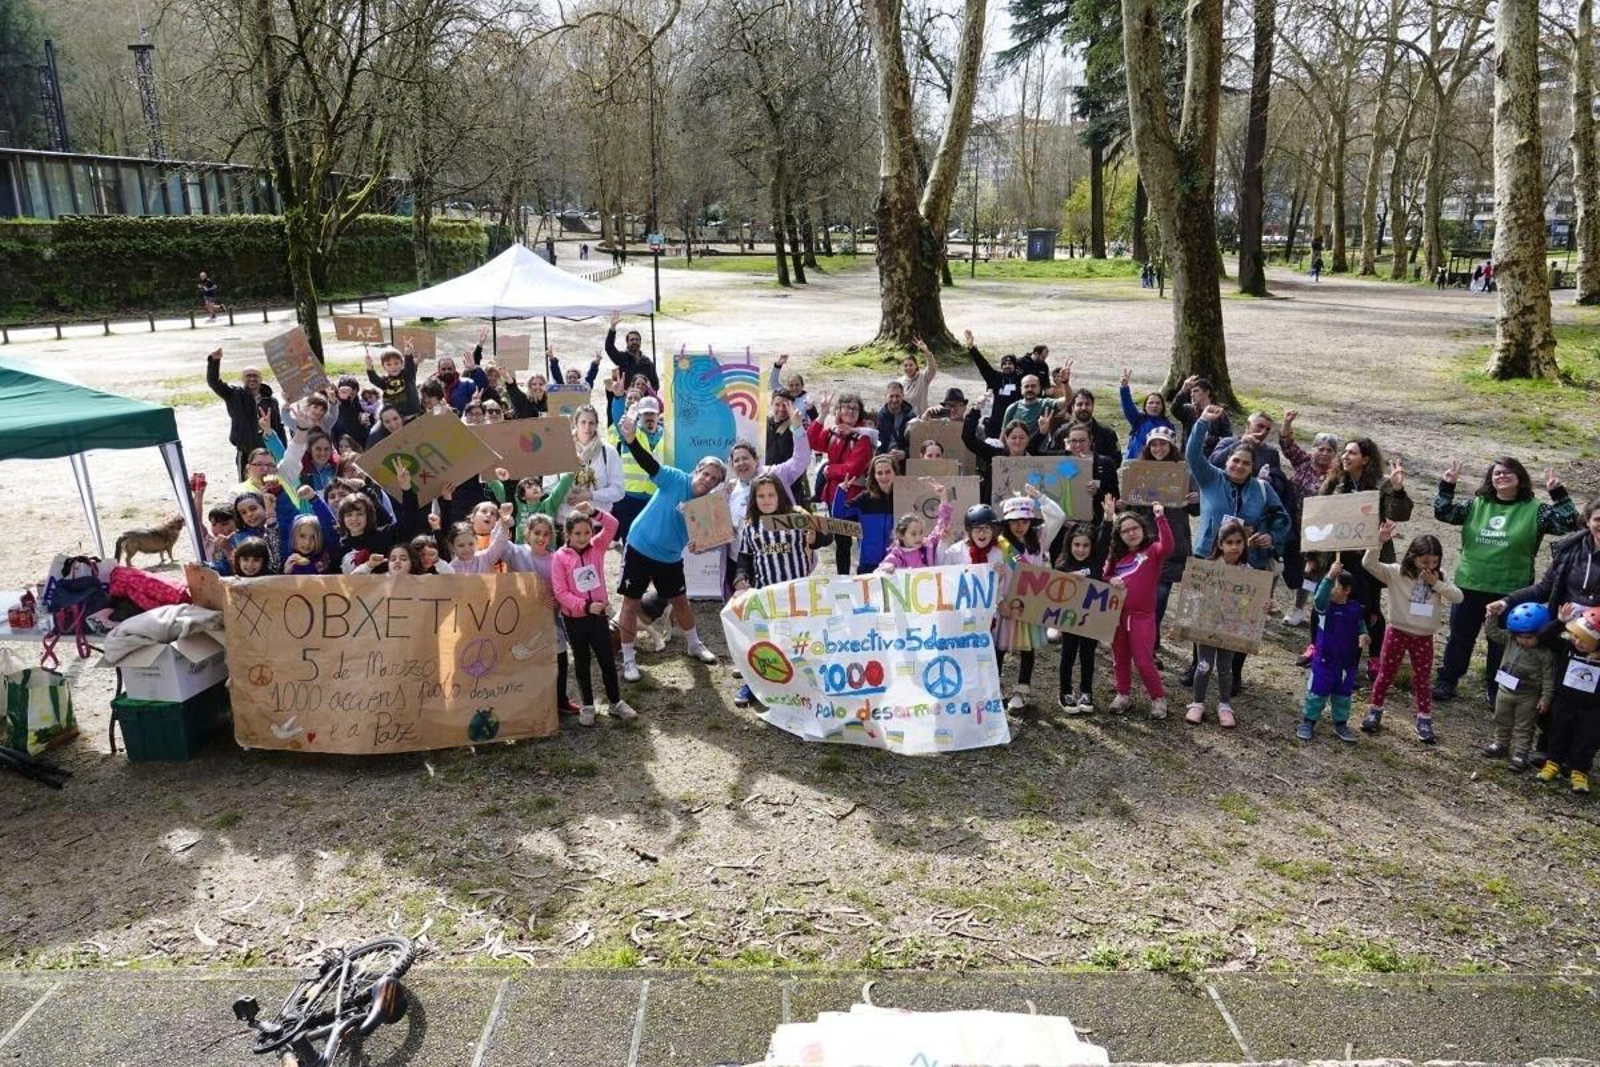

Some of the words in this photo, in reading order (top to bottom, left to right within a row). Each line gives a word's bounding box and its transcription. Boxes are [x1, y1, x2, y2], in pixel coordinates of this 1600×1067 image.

[347, 325, 378, 338] PAZ
[299, 647, 321, 682] 5
[332, 650, 351, 681] de
[819, 660, 885, 693] 1000
[271, 681, 322, 713] 1000
[946, 702, 957, 715] e
[961, 702, 971, 715] a
[975, 700, 1002, 725] paz
